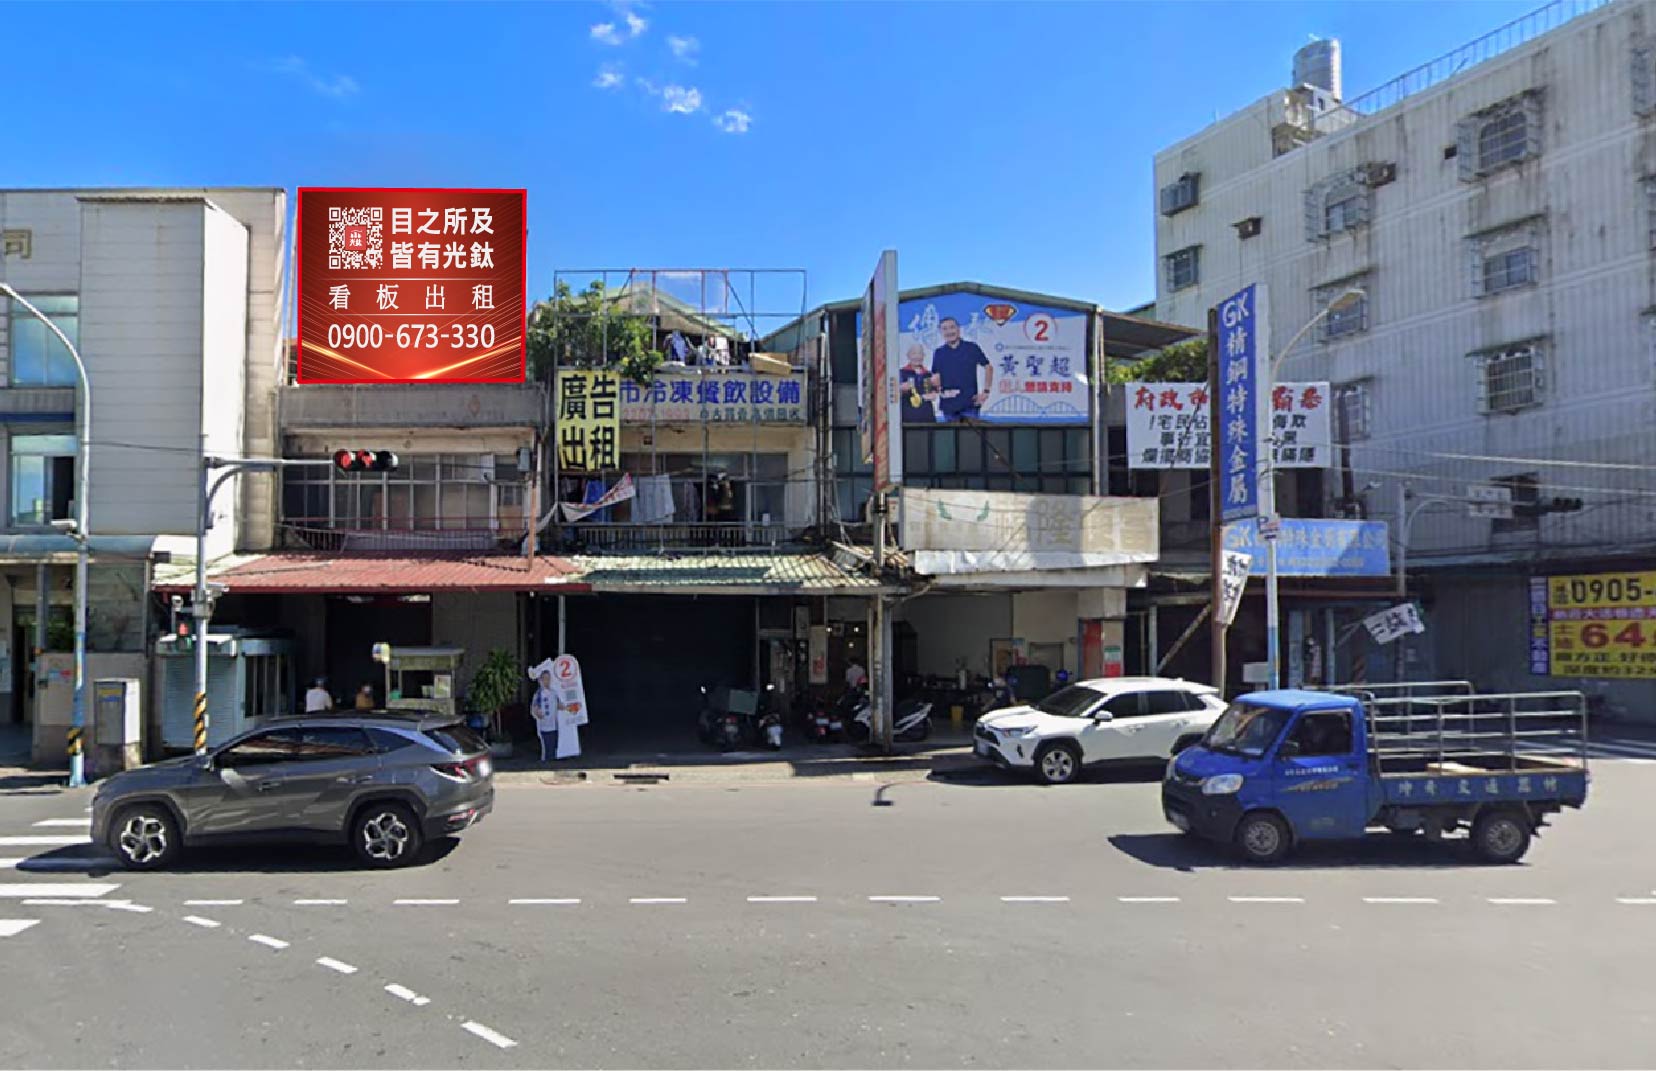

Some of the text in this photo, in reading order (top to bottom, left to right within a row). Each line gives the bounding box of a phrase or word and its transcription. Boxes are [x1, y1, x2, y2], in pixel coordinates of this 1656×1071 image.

[391, 207, 494, 235] 目之所及
[390, 241, 494, 269] 皆有光鈦
[328, 284, 495, 310] 看板出租
[328, 323, 495, 349] 0900-673-330
[1034, 319, 1049, 341] 2
[559, 373, 617, 420] 廣告
[560, 425, 617, 470] 出租
[1571, 578, 1656, 604] 0905-
[1582, 622, 1656, 649] 64
[560, 660, 571, 678] 2
